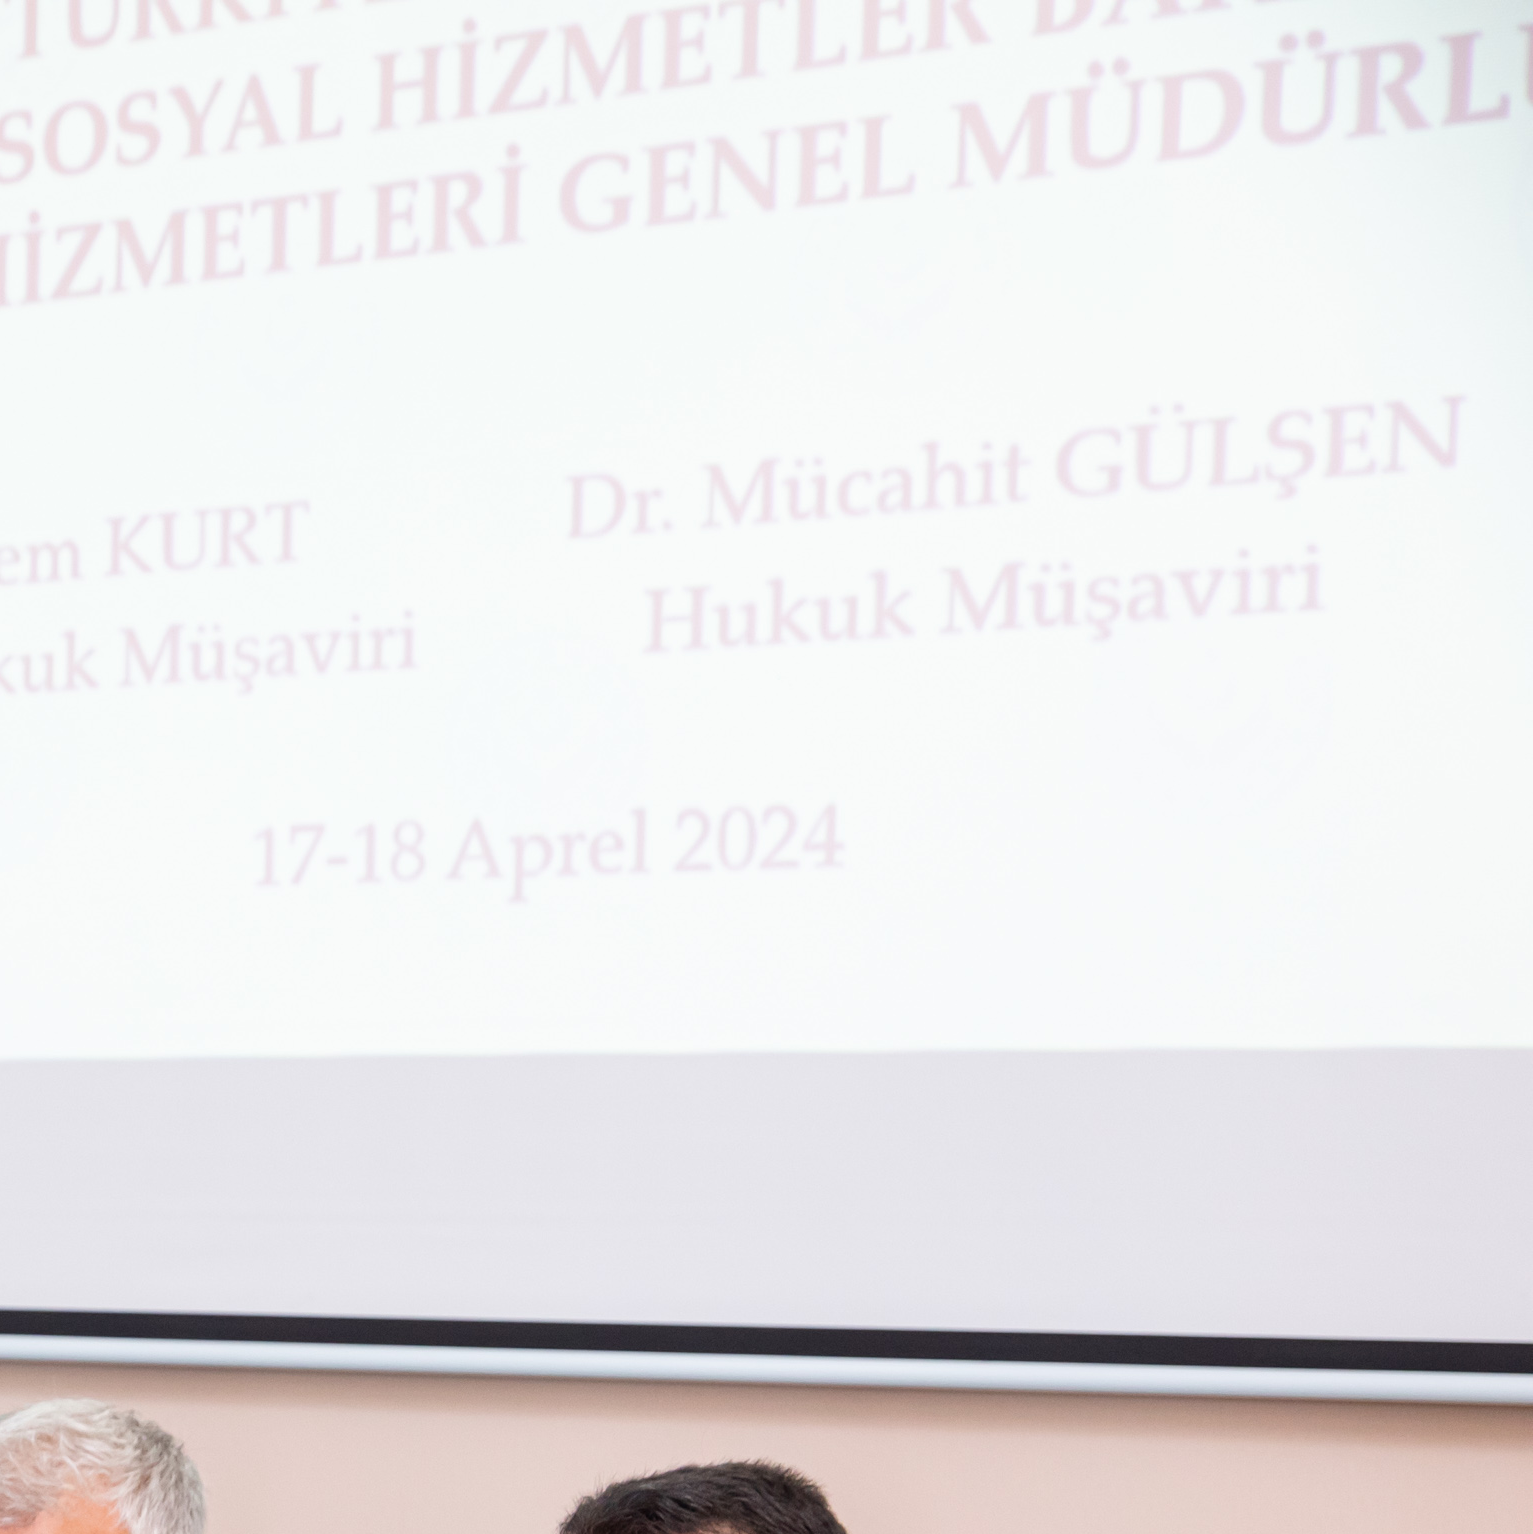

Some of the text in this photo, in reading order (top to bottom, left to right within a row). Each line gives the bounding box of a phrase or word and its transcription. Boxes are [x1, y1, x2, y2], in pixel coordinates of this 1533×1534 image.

[559, 115, 916, 233] GENEL
[949, 15, 1533, 188] MÜDÜRL
[568, 395, 1466, 538] Dr. Mücahit GÜLŞEN
[106, 500, 310, 576] KURT
[645, 544, 1321, 653] Hukuk Müşaviri
[121, 611, 415, 693] Müşaviri
[257, 804, 844, 903] 17-18 Aprel 2024
